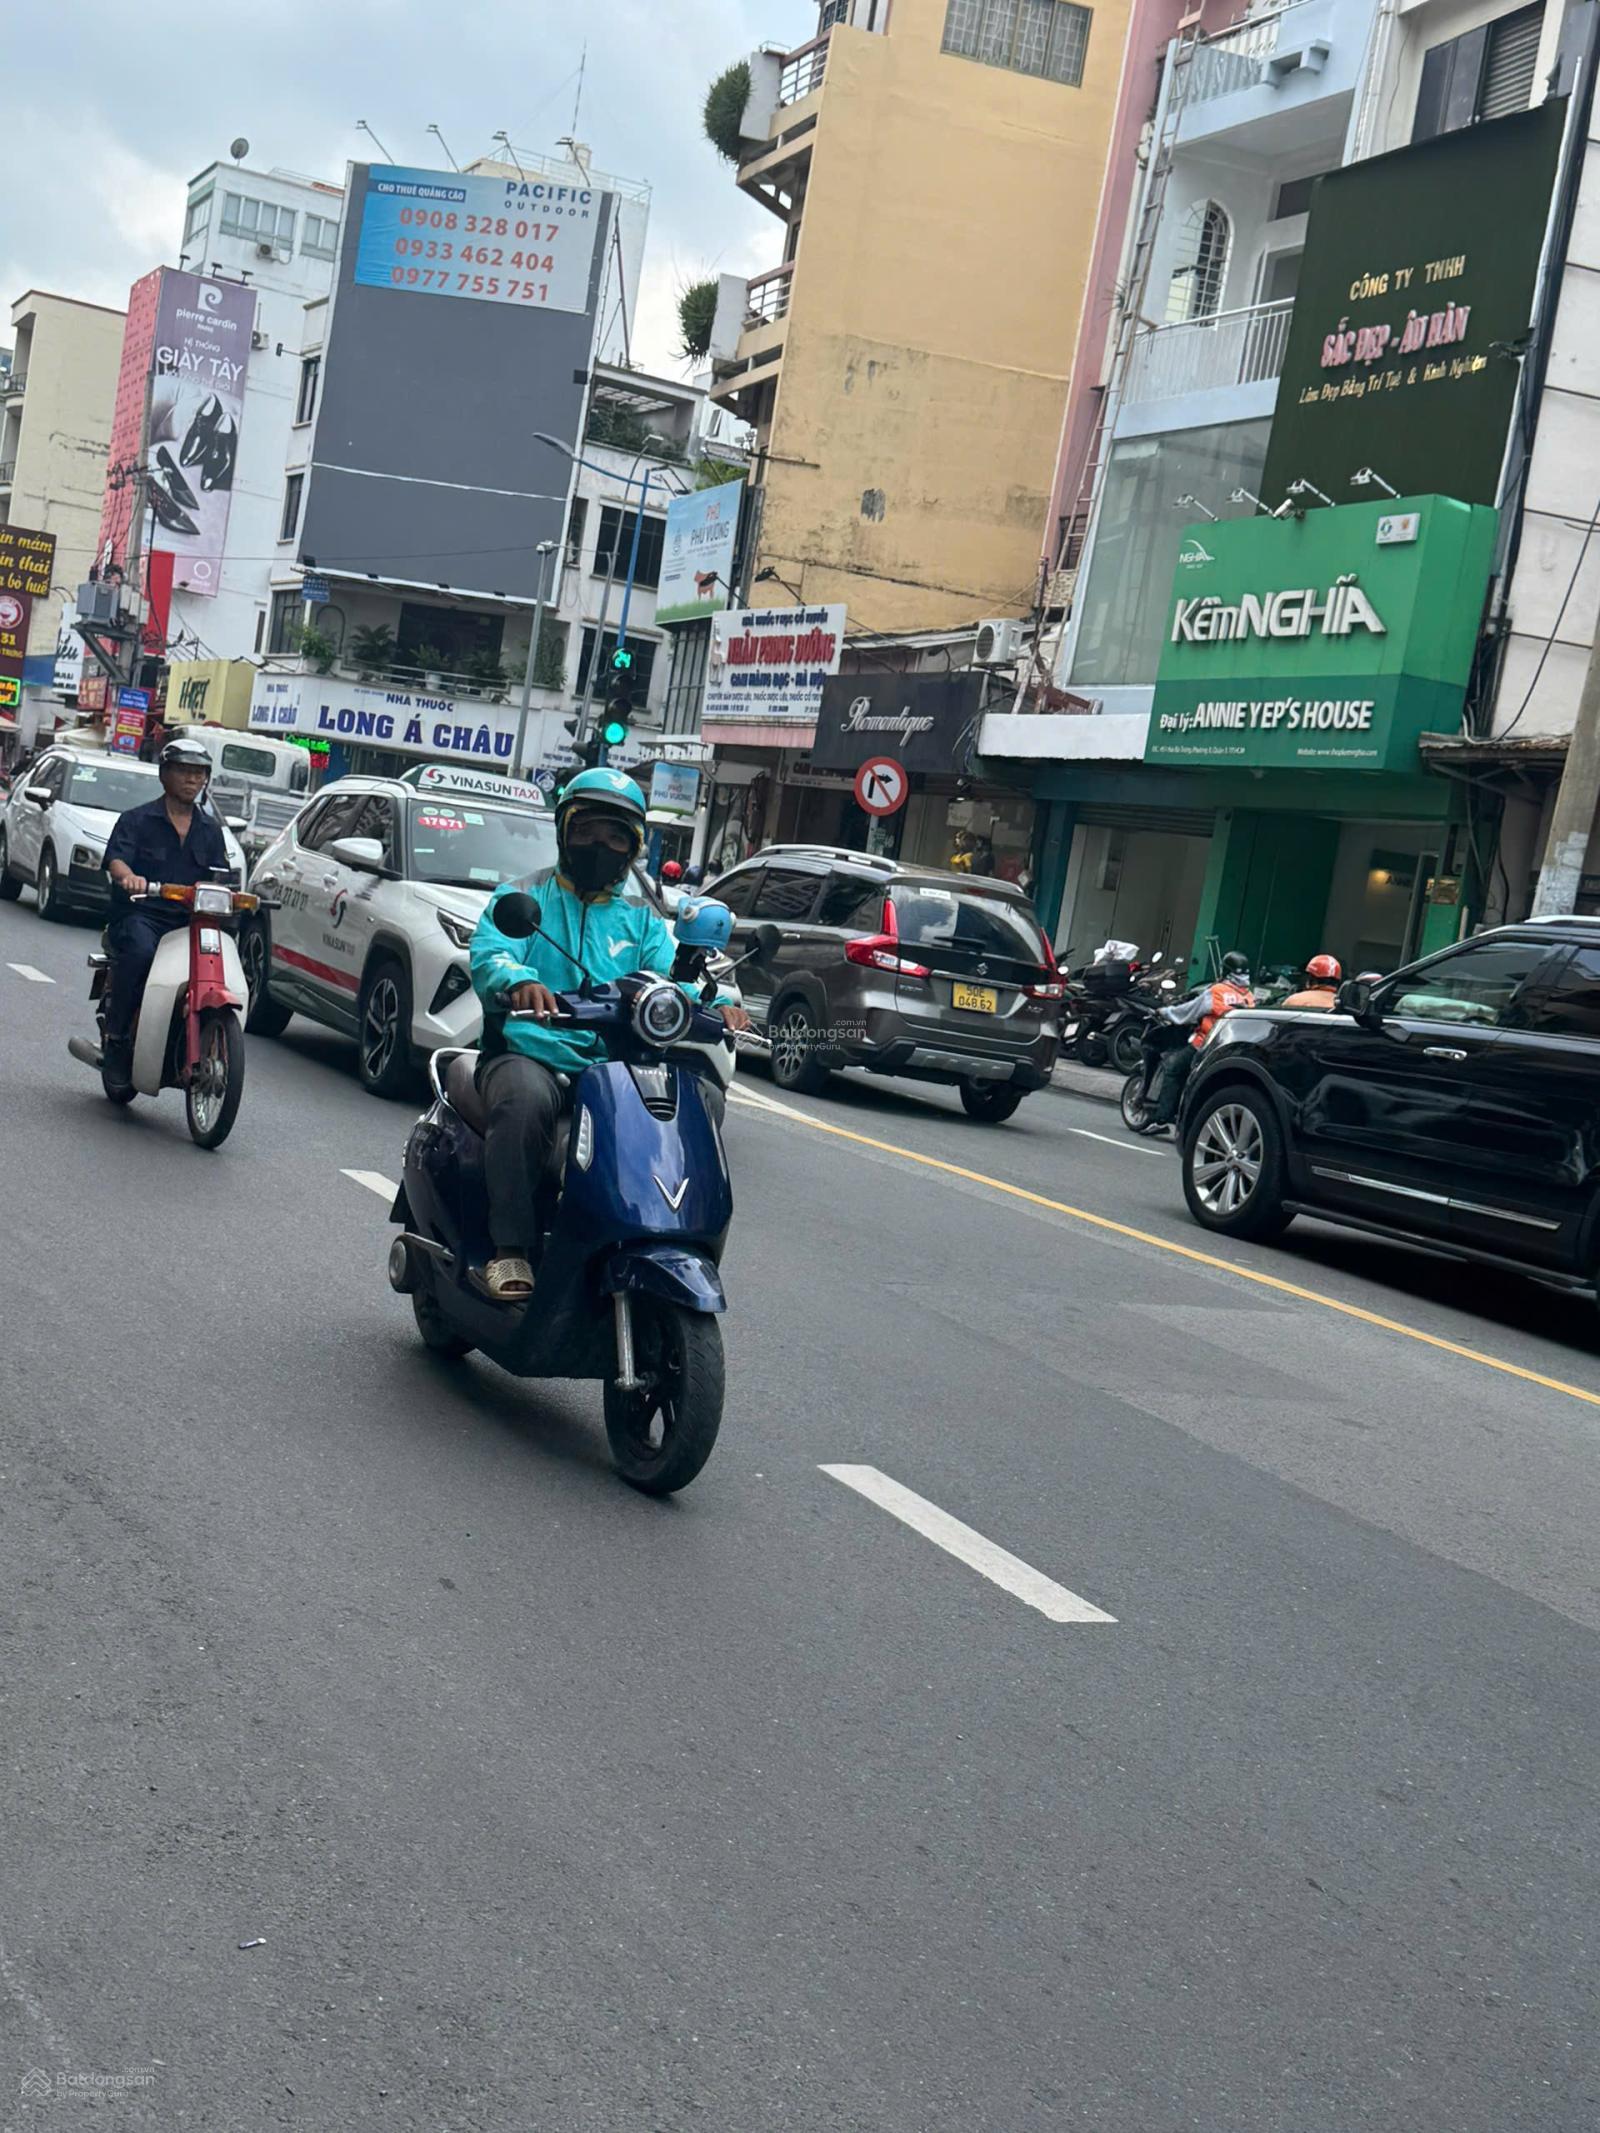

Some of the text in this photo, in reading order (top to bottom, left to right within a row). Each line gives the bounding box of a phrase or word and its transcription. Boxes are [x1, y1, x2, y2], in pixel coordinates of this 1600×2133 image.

[378, 183, 395, 193] CHO
[506, 181, 592, 205] PACIFIC
[400, 207, 559, 242] 0908 328 017
[504, 200, 590, 218] OUTDOOR
[395, 238, 554, 273] 0933 462 404
[391, 266, 548, 301] 0977 755 751
[1350, 254, 1467, 301] CÔNG TY TNHH
[176, 308, 237, 331] pierre cardin
[157, 346, 204, 372] GIÀY
[209, 356, 243, 382] TÂY
[318, 706, 515, 758] LONG Á CHÂU
[840, 696, 935, 747] Romantique
[1160, 713, 1178, 733] Đại
[1193, 702, 1248, 728] ANNIE
[1302, 701, 1375, 729] HOUSE
